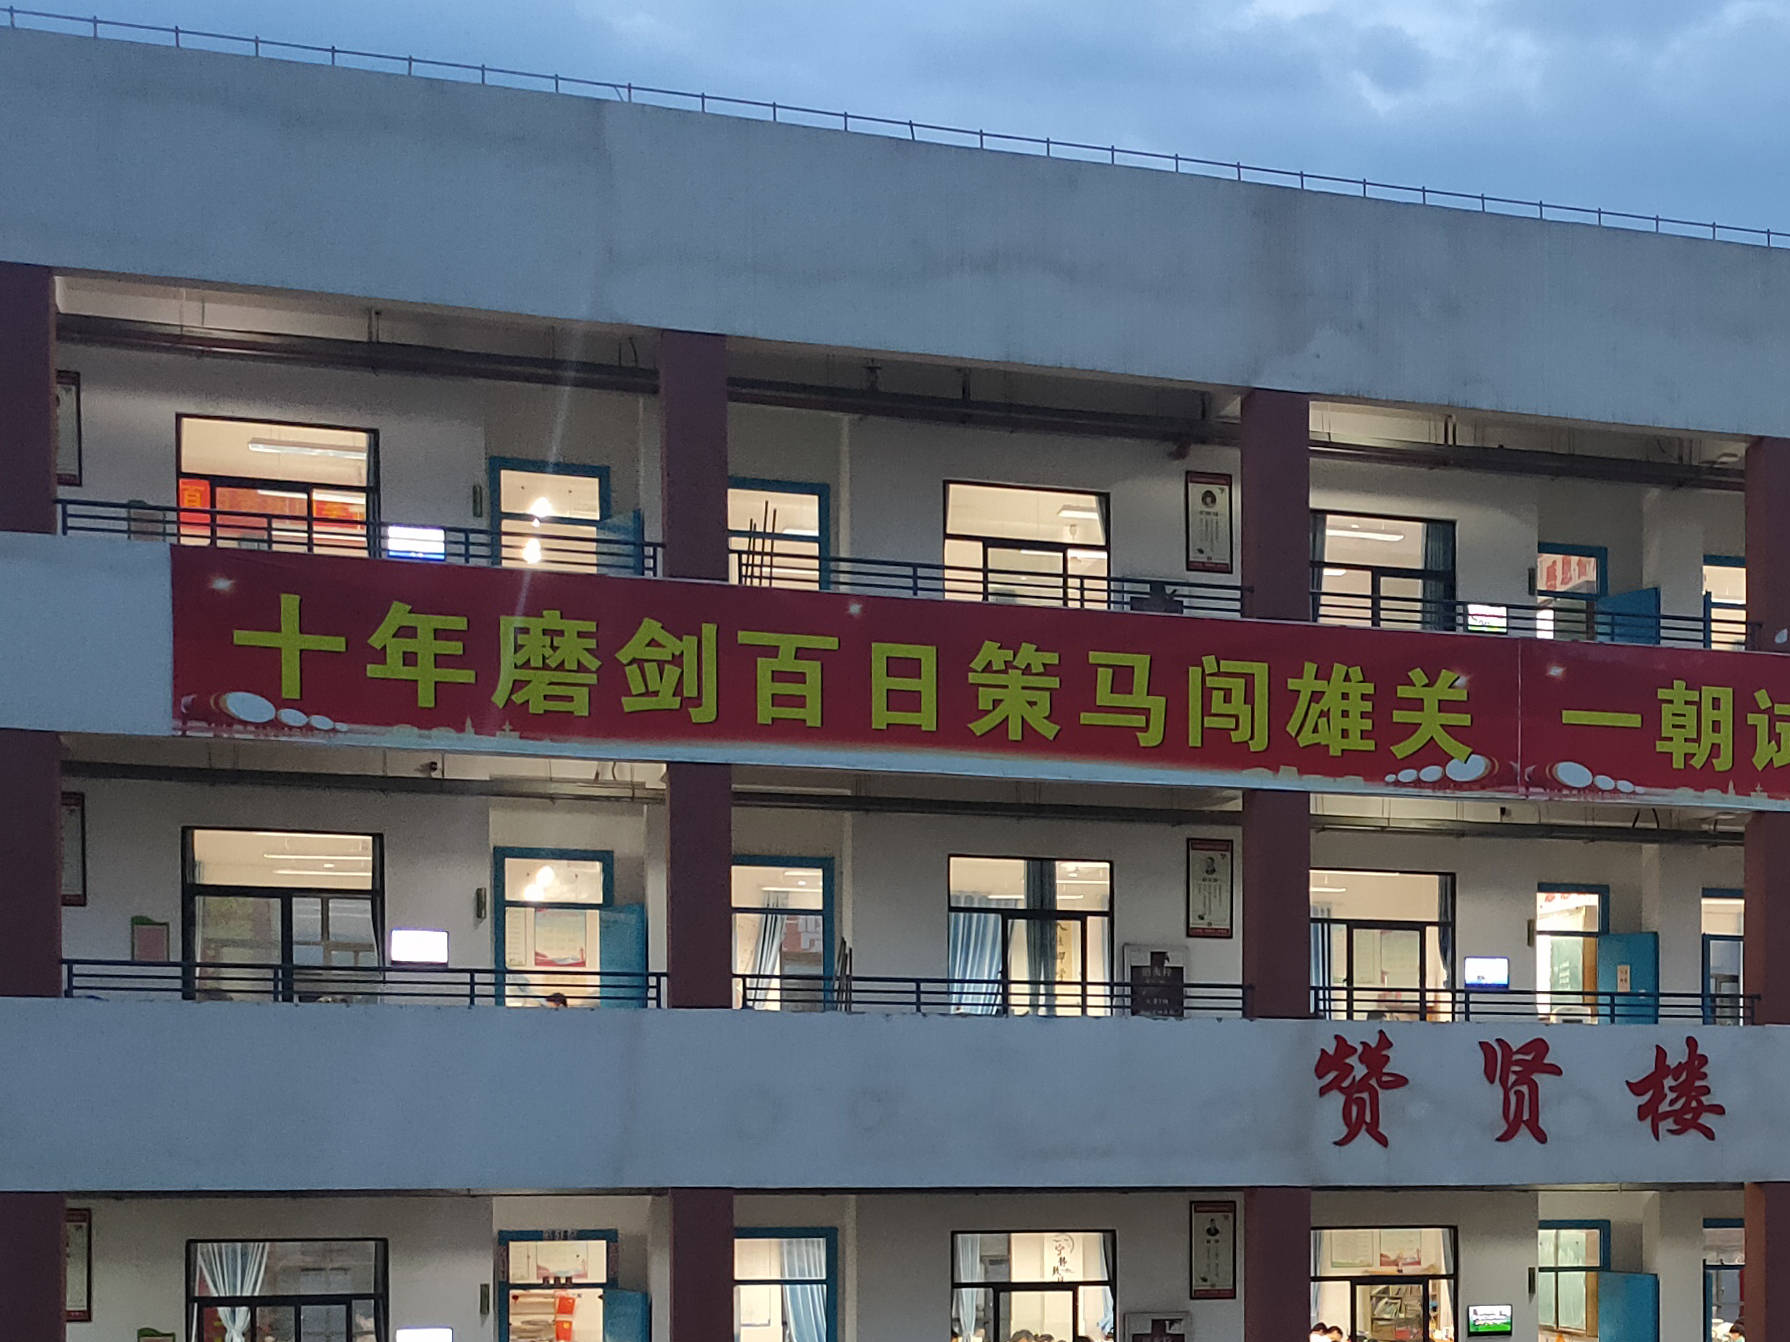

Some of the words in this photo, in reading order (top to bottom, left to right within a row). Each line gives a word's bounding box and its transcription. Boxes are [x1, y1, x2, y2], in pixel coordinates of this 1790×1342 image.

[233, 593, 1474, 764] 十年磨剑百日策马闯雄关
